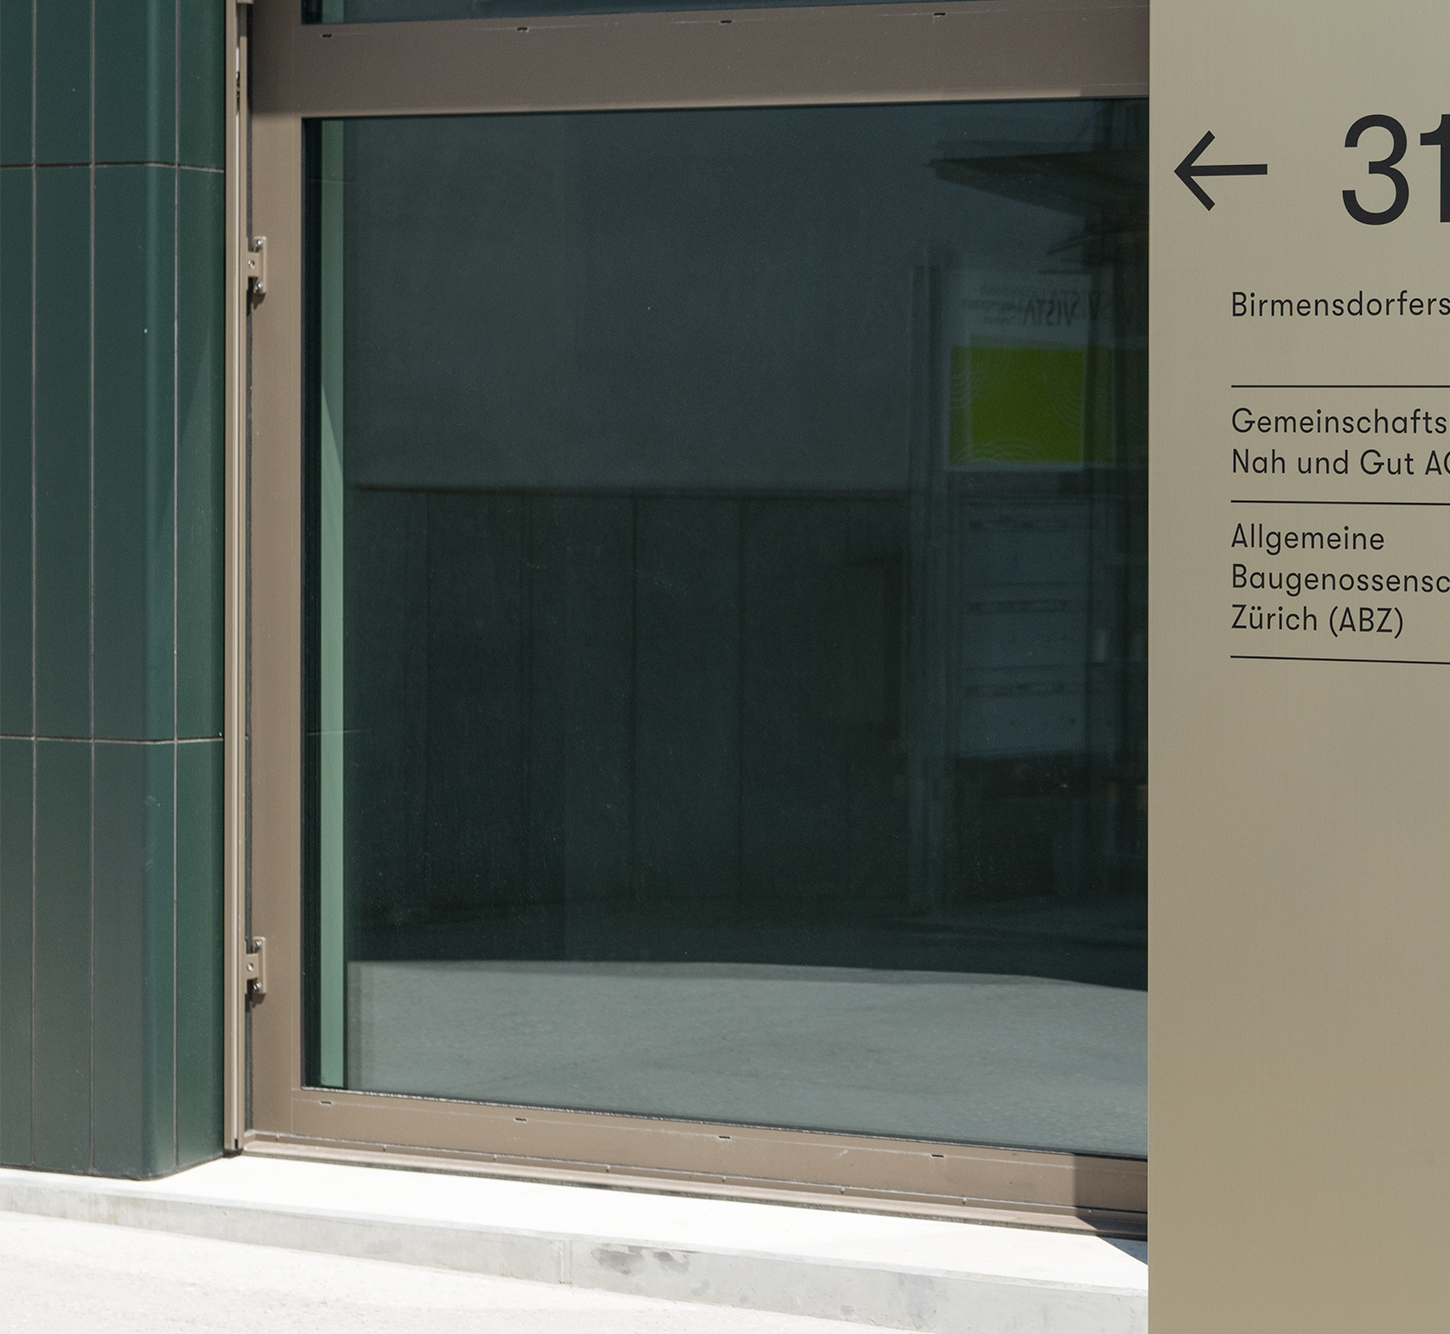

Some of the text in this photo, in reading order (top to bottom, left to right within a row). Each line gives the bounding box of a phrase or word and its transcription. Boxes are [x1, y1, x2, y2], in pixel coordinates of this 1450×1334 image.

[1232, 448, 1286, 474] Nah
[1297, 449, 1349, 475] und
[1360, 448, 1415, 475] Gut
[1231, 523, 1385, 555] Allgemeine
[1231, 604, 1404, 639] Zürich (ABZ)
